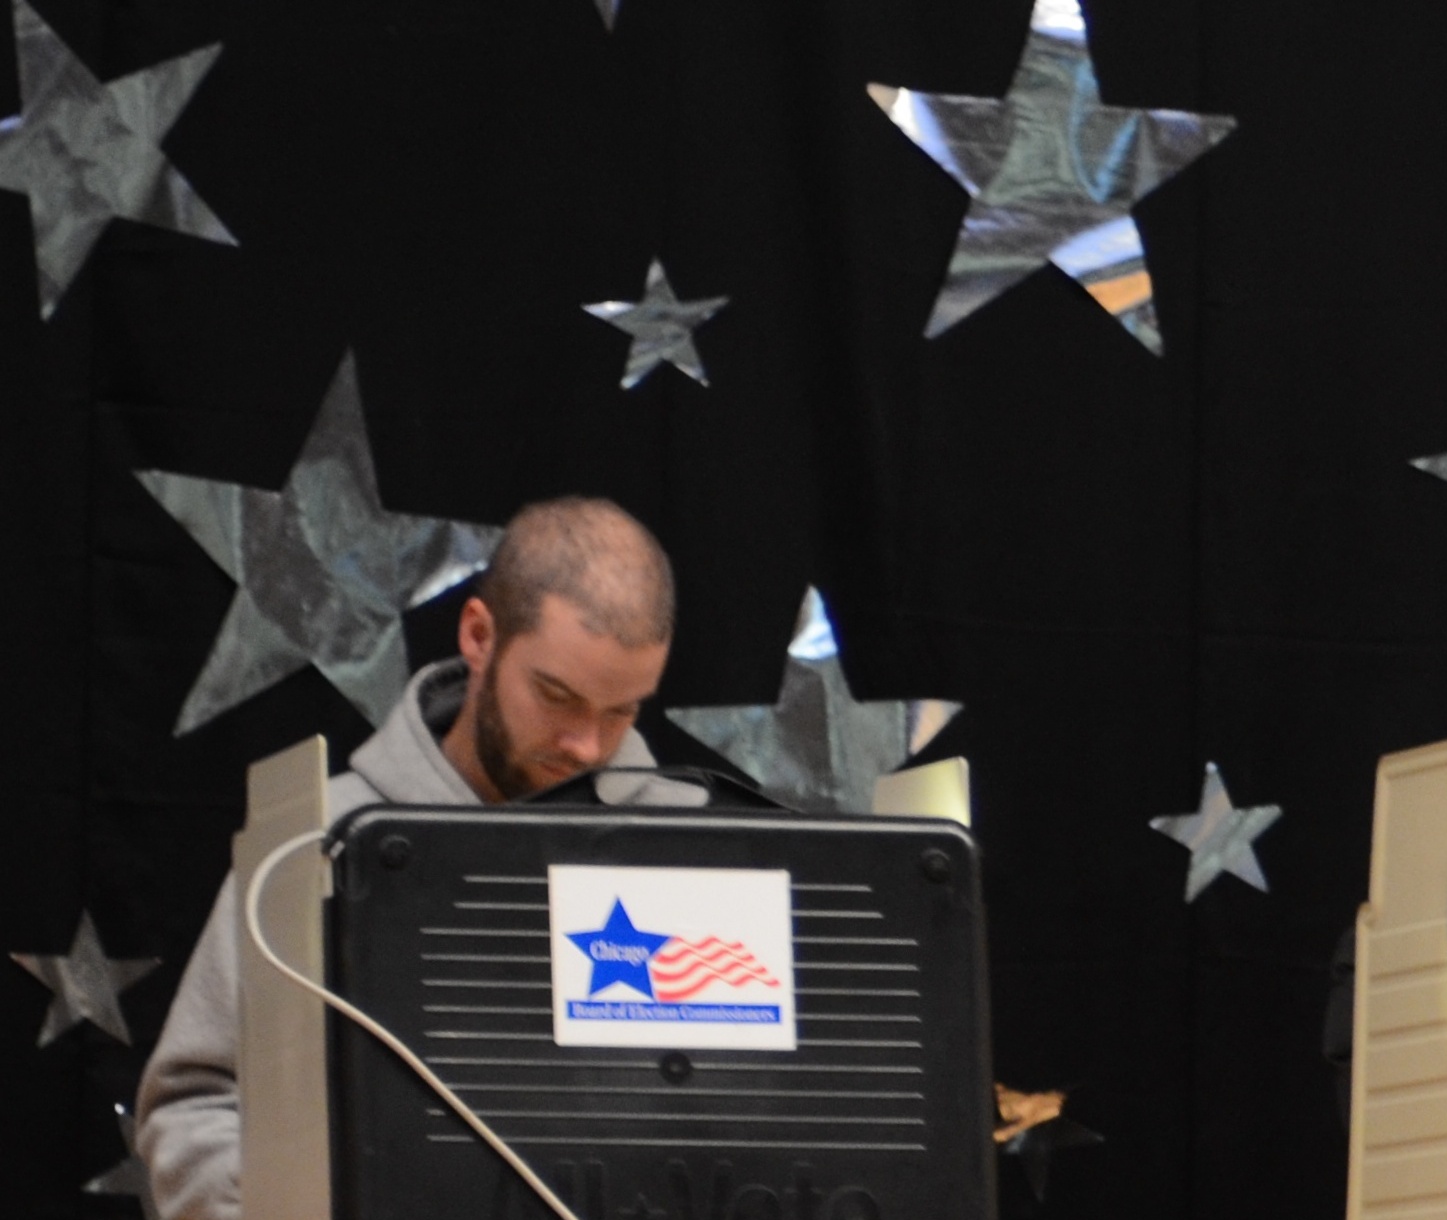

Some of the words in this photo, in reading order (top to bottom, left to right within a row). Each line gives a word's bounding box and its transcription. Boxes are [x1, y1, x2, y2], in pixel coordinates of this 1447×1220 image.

[589, 940, 650, 967] Chicago
[628, 1003, 678, 1020] Election
[680, 1004, 775, 1023] Commissioners
